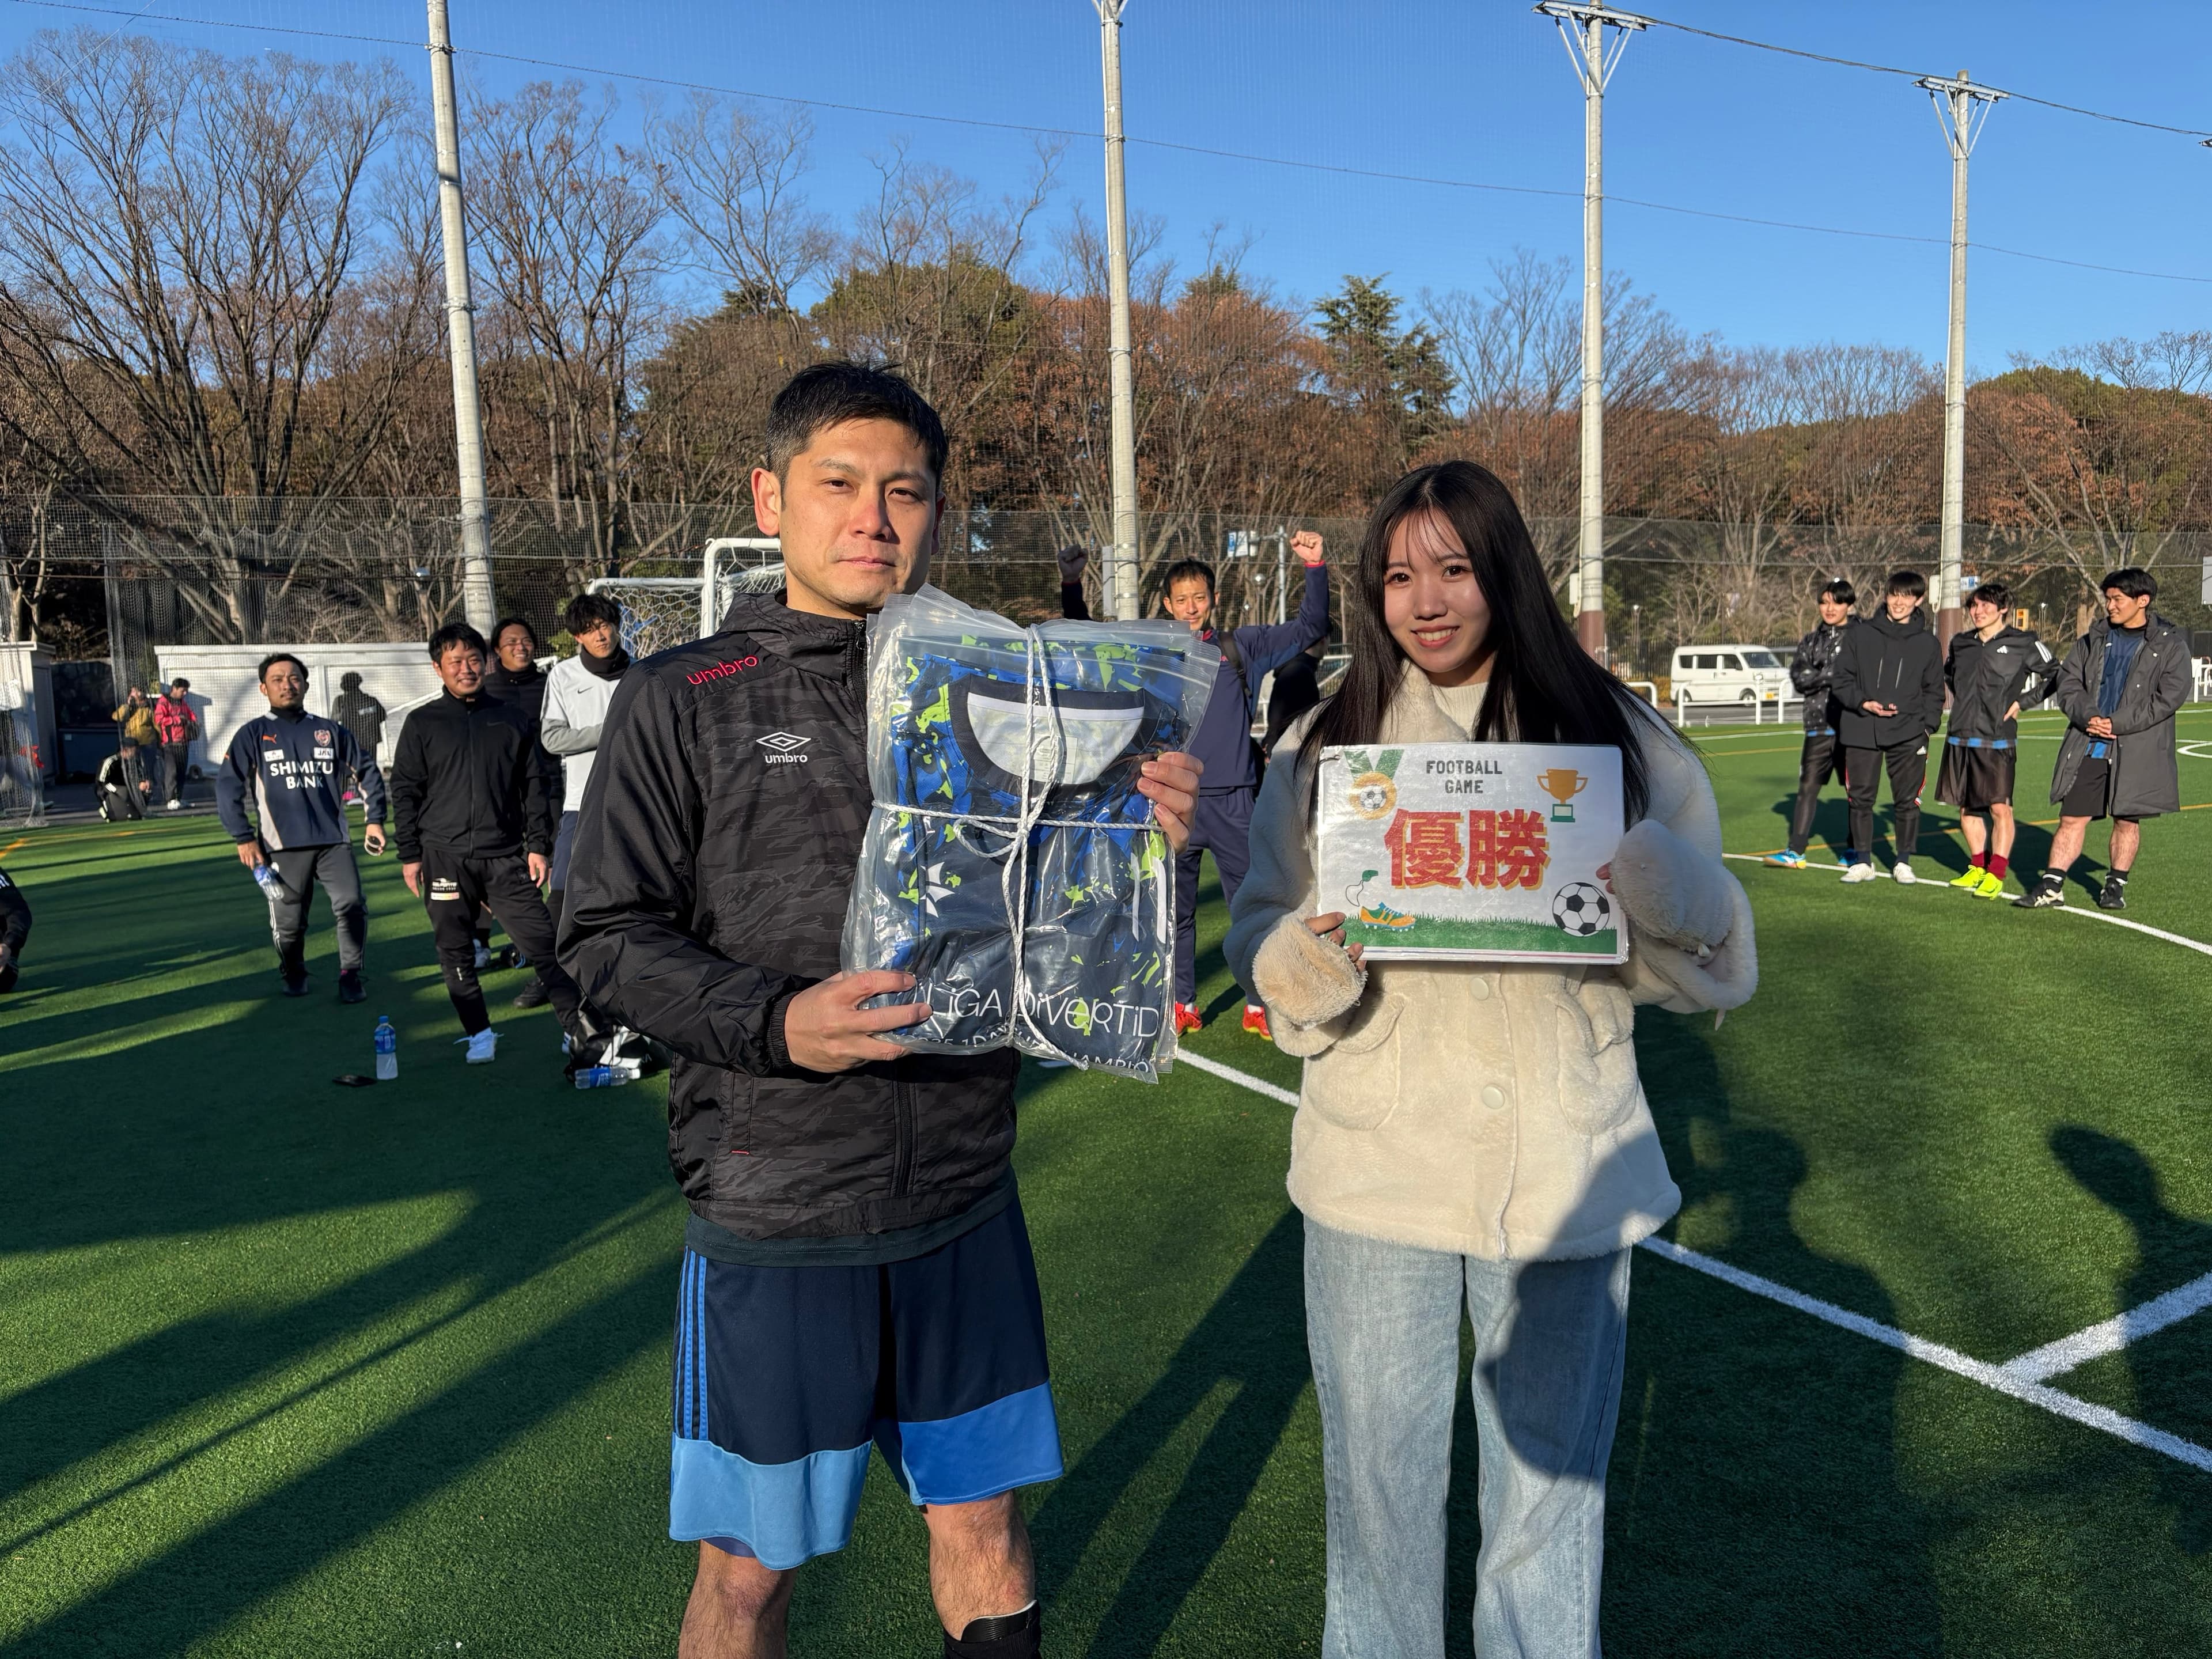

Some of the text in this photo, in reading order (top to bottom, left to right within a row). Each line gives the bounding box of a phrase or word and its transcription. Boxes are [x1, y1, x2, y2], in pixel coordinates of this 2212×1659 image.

[686, 655, 758, 685] umbro
[765, 753, 808, 763] umbro
[270, 761, 334, 777] SHIMIZU
[1426, 760, 1502, 774] FOOTBALL
[286, 775, 323, 789] BANK
[1445, 779, 1484, 794] GAME
[1384, 809, 1551, 891] 優勝
